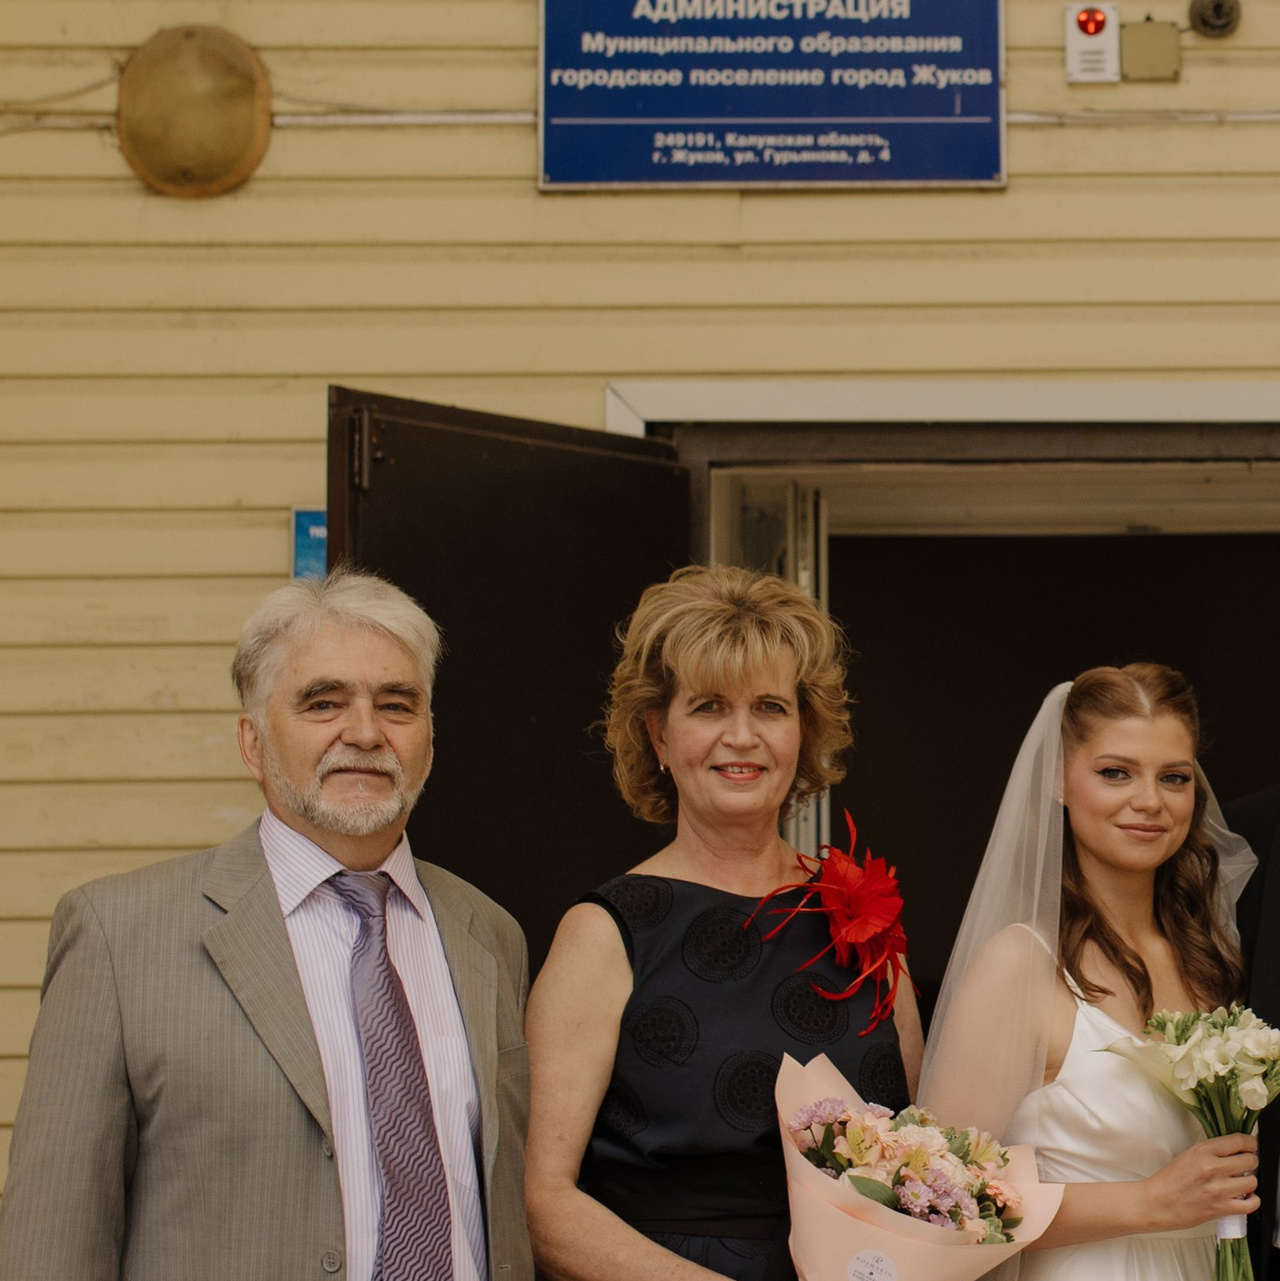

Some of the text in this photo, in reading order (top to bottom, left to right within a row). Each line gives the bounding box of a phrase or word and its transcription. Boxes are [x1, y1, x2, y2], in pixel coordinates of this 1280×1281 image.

[581, 31, 963, 57] Муниципального образования
[550, 64, 993, 90] городское поселение город Жуков
[725, 132, 815, 150] Калужская
[879, 146, 892, 162] 4
